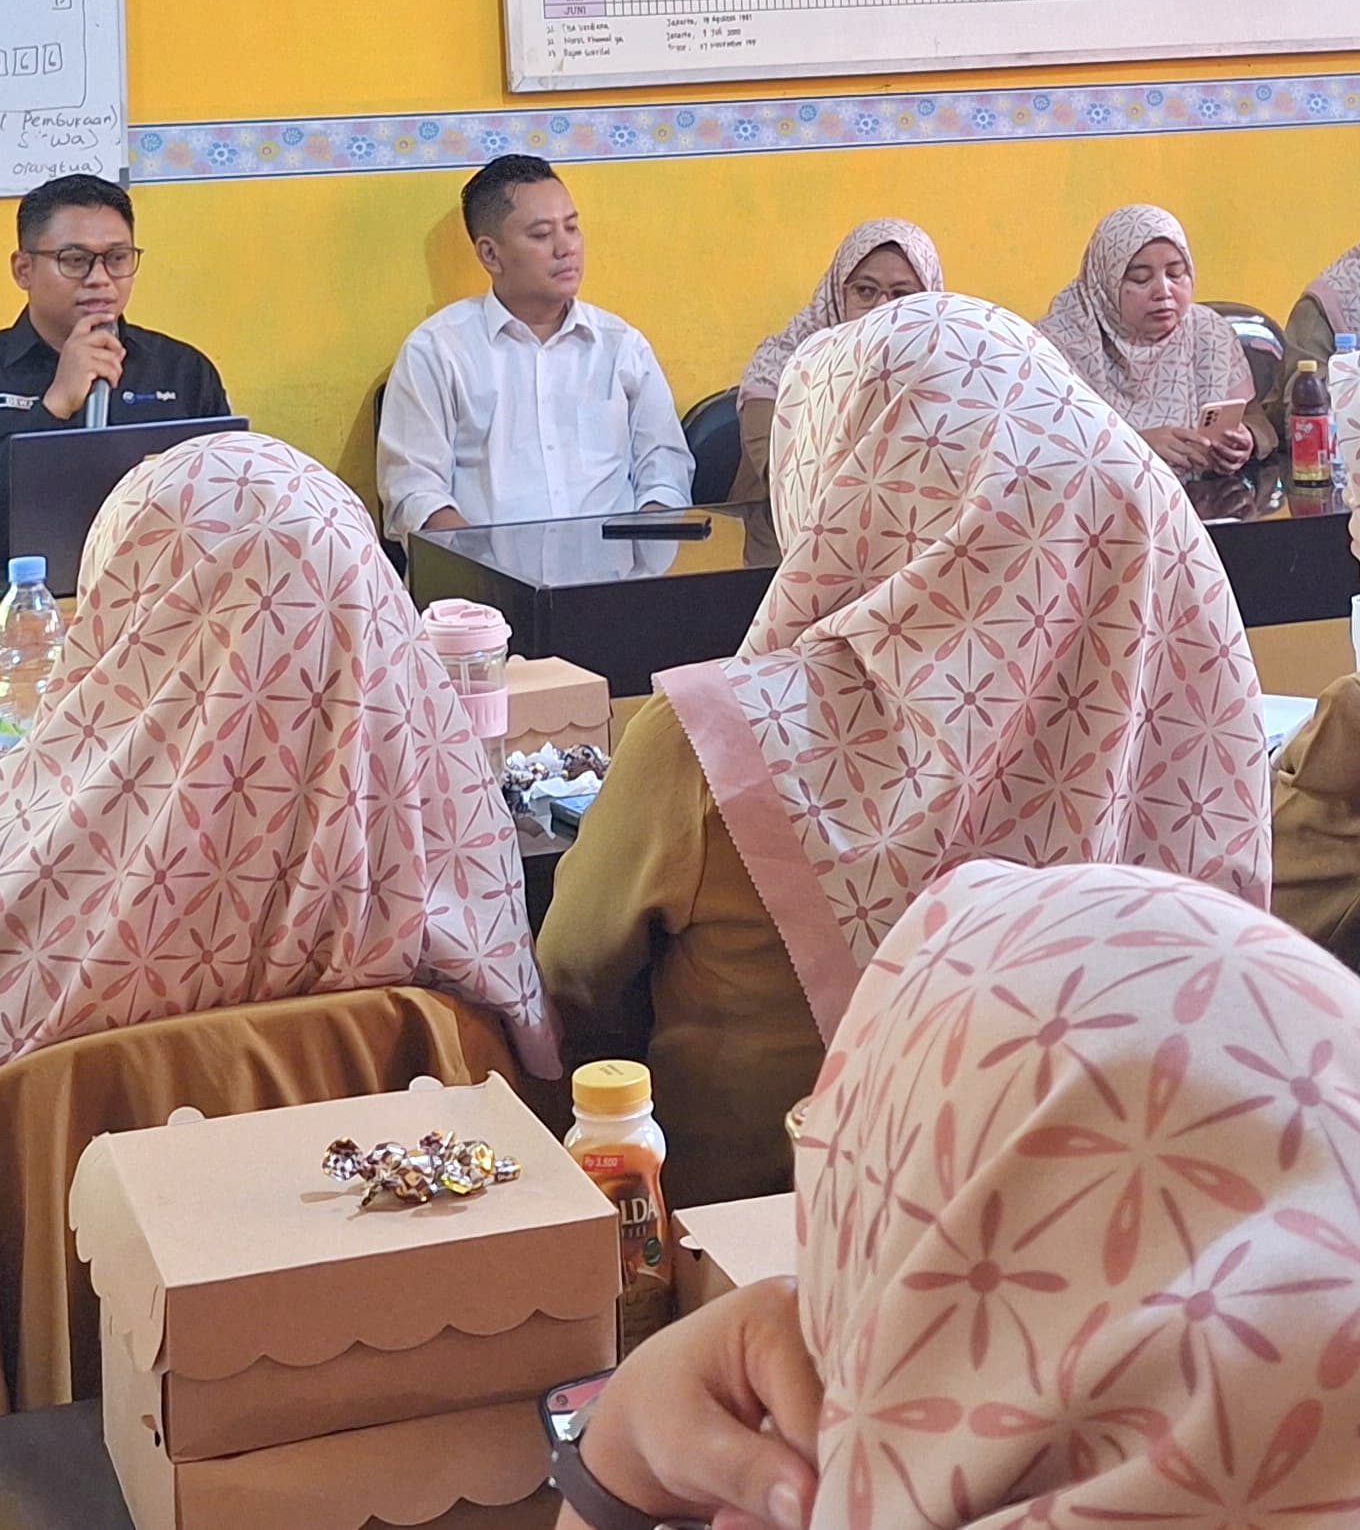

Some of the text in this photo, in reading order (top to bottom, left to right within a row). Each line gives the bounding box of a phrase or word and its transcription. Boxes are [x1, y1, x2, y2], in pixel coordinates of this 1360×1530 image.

[564, 6, 586, 15] JUNI
[20, 52, 30, 70] 6
[48, 53, 57, 67] 6
[619, 1197, 659, 1225] LDA
